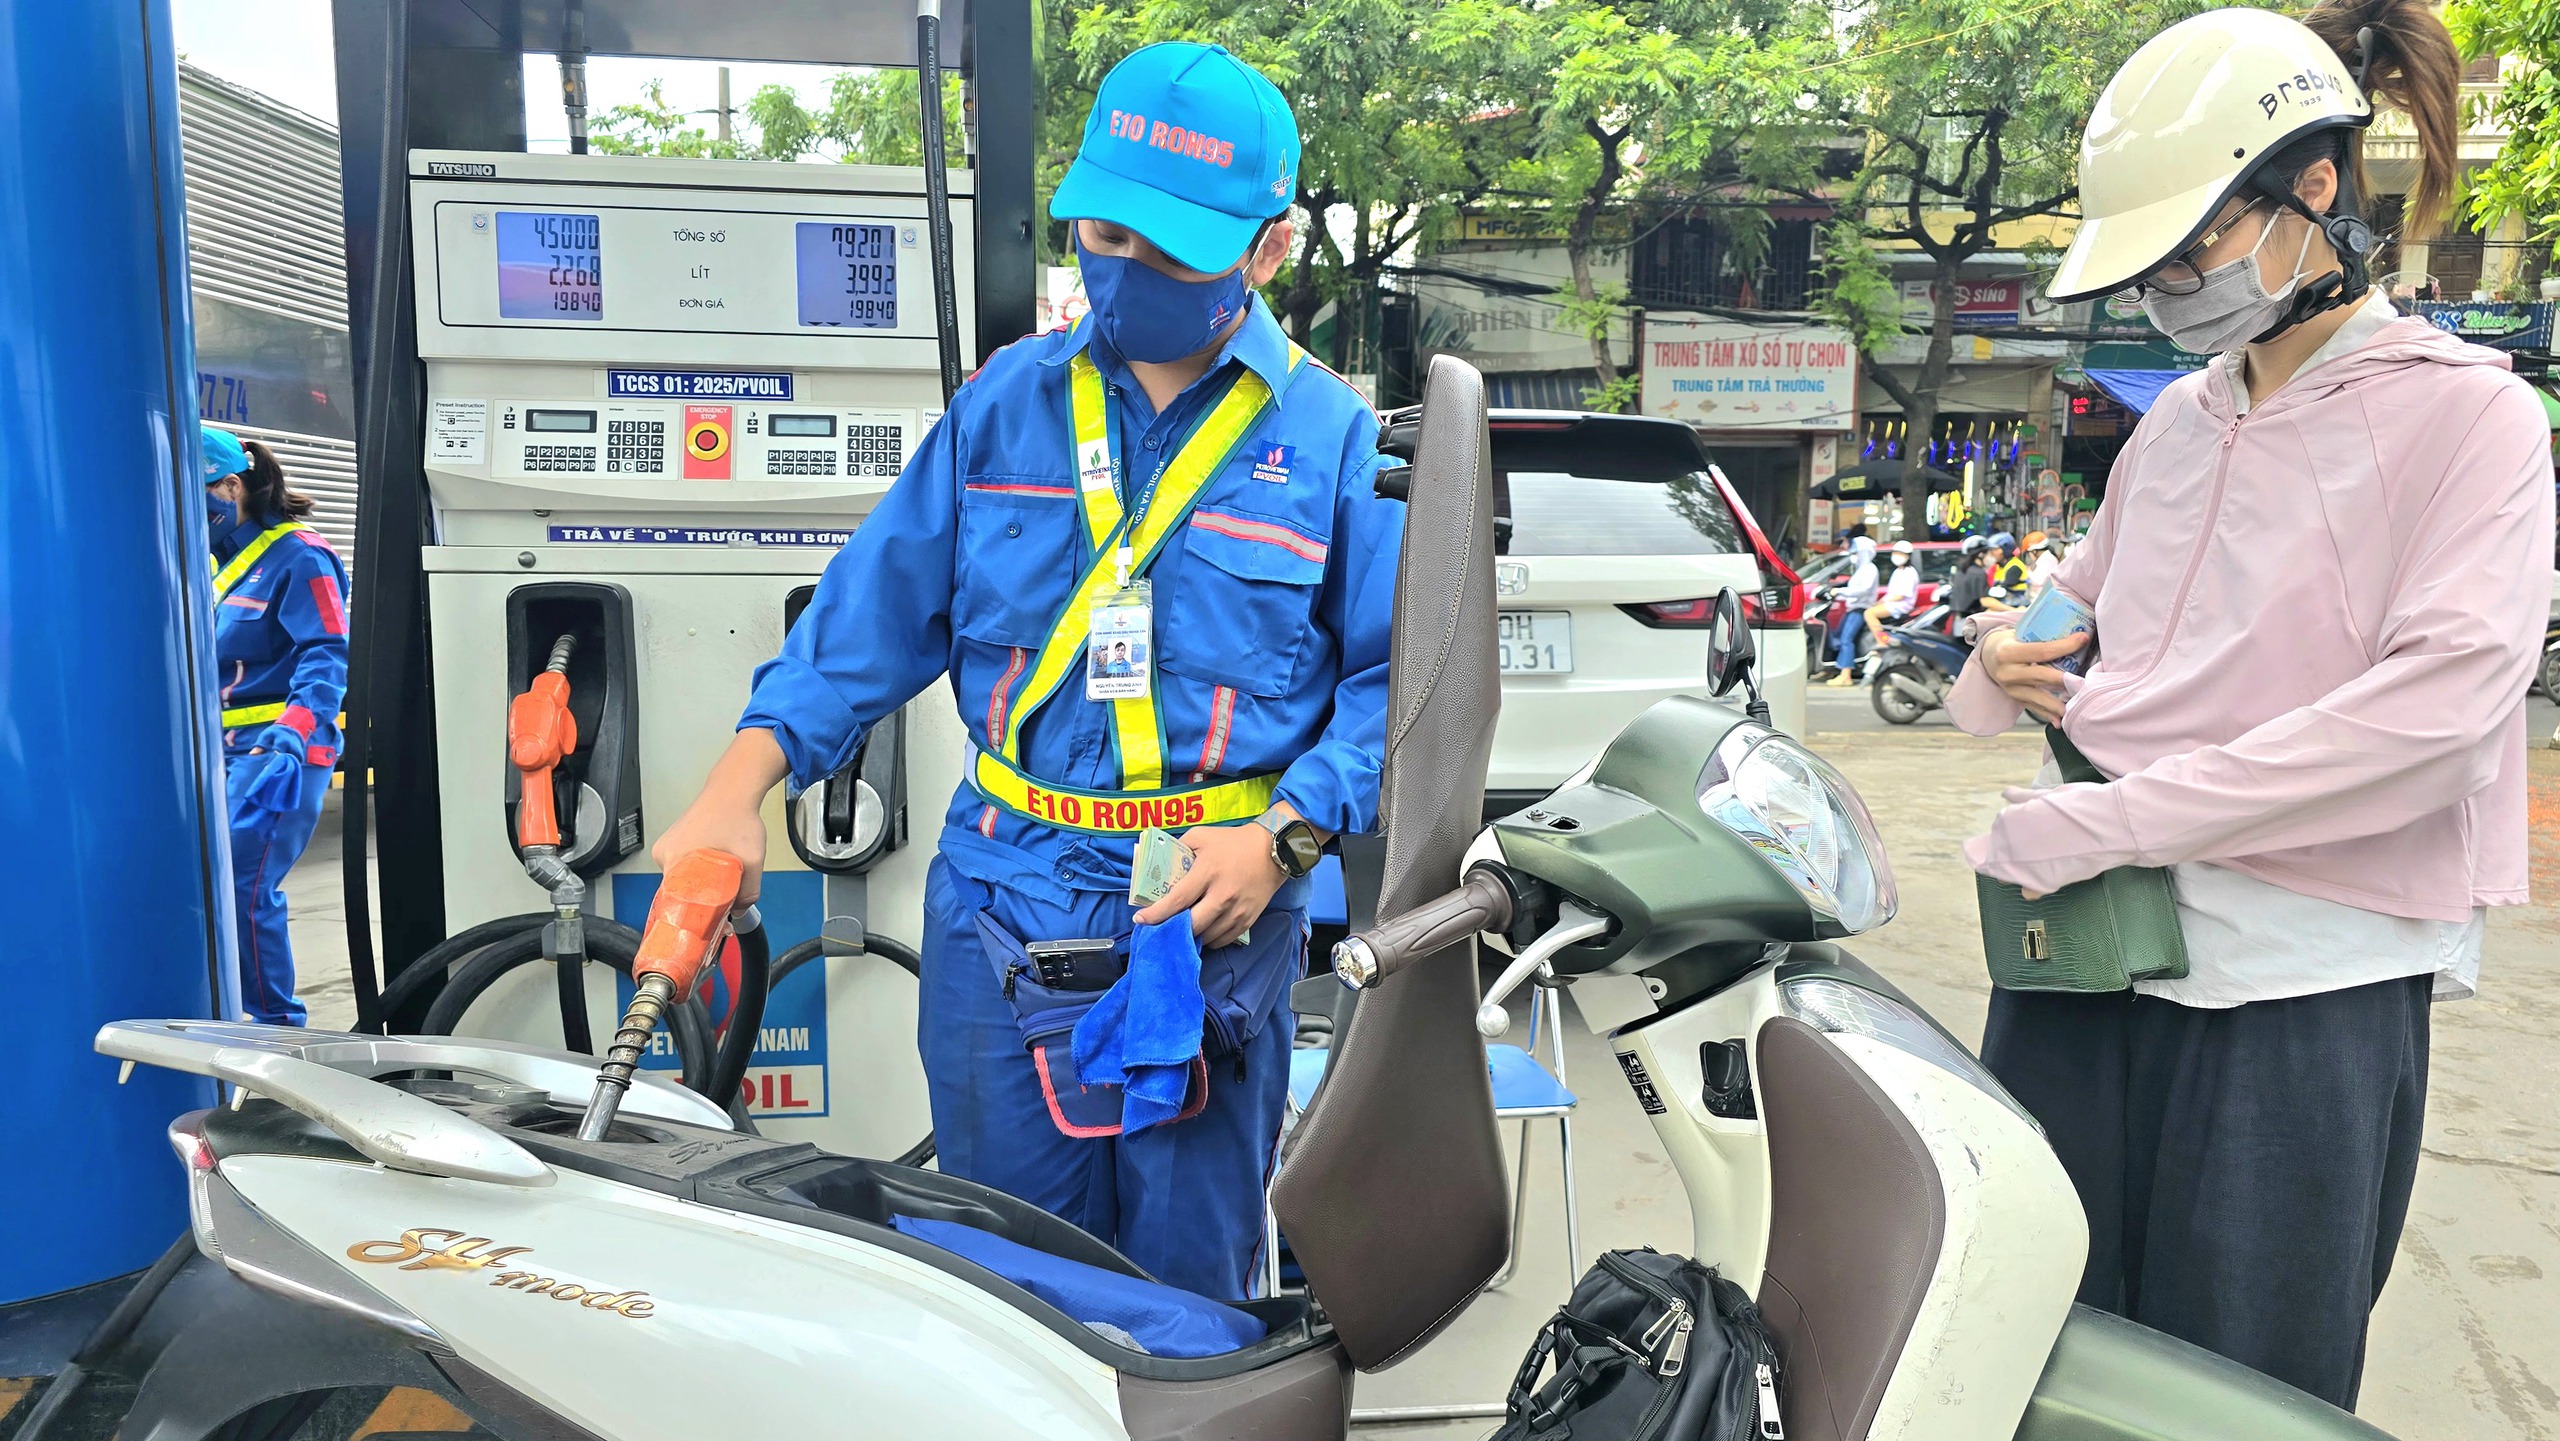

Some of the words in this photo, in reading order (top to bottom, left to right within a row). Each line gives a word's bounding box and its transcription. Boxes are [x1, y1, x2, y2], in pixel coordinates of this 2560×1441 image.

[2258, 69, 2343, 121] Brabus
[1109, 109, 1146, 142] E10
[1149, 119, 1235, 168] RON95
[431, 163, 493, 176] TATSUNO
[534, 217, 599, 250] 45000
[673, 227, 705, 242] TỔNG
[710, 229, 726, 242] SỐ
[832, 227, 894, 258] 79201
[549, 255, 600, 287] 2,268
[691, 265, 710, 279] LÍT
[847, 264, 895, 296] 3,992
[554, 292, 600, 312] 19840
[1973, 288, 2007, 303] SINO
[705, 298, 725, 309] GIÁ
[850, 300, 895, 319] 19840
[2462, 310, 2527, 333] Bakery
[1654, 342, 1700, 367] TRUNG
[1705, 337, 1734, 367] TÂM
[1738, 333, 1759, 367] XỔ
[1762, 333, 1781, 367] SỐ
[1786, 340, 1805, 373] TỰ
[1807, 343, 1846, 373] CHỌN
[617, 375, 660, 393] TCCS
[664, 375, 689, 393] 01:
[693, 376, 784, 395] 2025/PVOIL
[1672, 379, 1713, 393] TRUNG
[1718, 377, 1743, 393] TÂM
[1748, 376, 1771, 393] TRẢ
[611, 422, 619, 431] 7
[625, 422, 633, 432] 8
[639, 423, 647, 432] 9
[850, 427, 858, 435] 7
[878, 428, 885, 436] 9
[610, 435, 618, 444] 4
[625, 436, 633, 445] 5
[639, 436, 647, 445] 6
[850, 440, 858, 448] 4
[864, 440, 871, 449] 5
[877, 441, 885, 449] 6
[526, 448, 537, 456] P1
[540, 448, 551, 456] P2
[584, 449, 595, 457] P5
[611, 449, 616, 458] 1
[624, 449, 632, 458] 2
[639, 449, 646, 458] 3
[783, 452, 793, 460] P2
[824, 453, 835, 461] P5
[850, 453, 855, 461] 1
[863, 453, 871, 462] 2
[877, 454, 885, 462] 3
[525, 461, 536, 469] P6
[583, 462, 595, 470] P10
[610, 462, 617, 471] 0
[624, 462, 632, 471] C
[850, 466, 857, 475] 0
[864, 466, 871, 475] C
[1147, 461, 1165, 489] PVOIL
[1256, 472, 1283, 483] PVOIL
[561, 527, 604, 540] TRẢ
[610, 526, 635, 540] VỀ
[684, 529, 755, 542] TRƯỚC
[760, 532, 796, 543] KHI
[802, 532, 849, 544] BƠM
[1026, 785, 1081, 825] E10
[1093, 794, 1205, 830] RON95
[489, 1270, 655, 1319] mode
